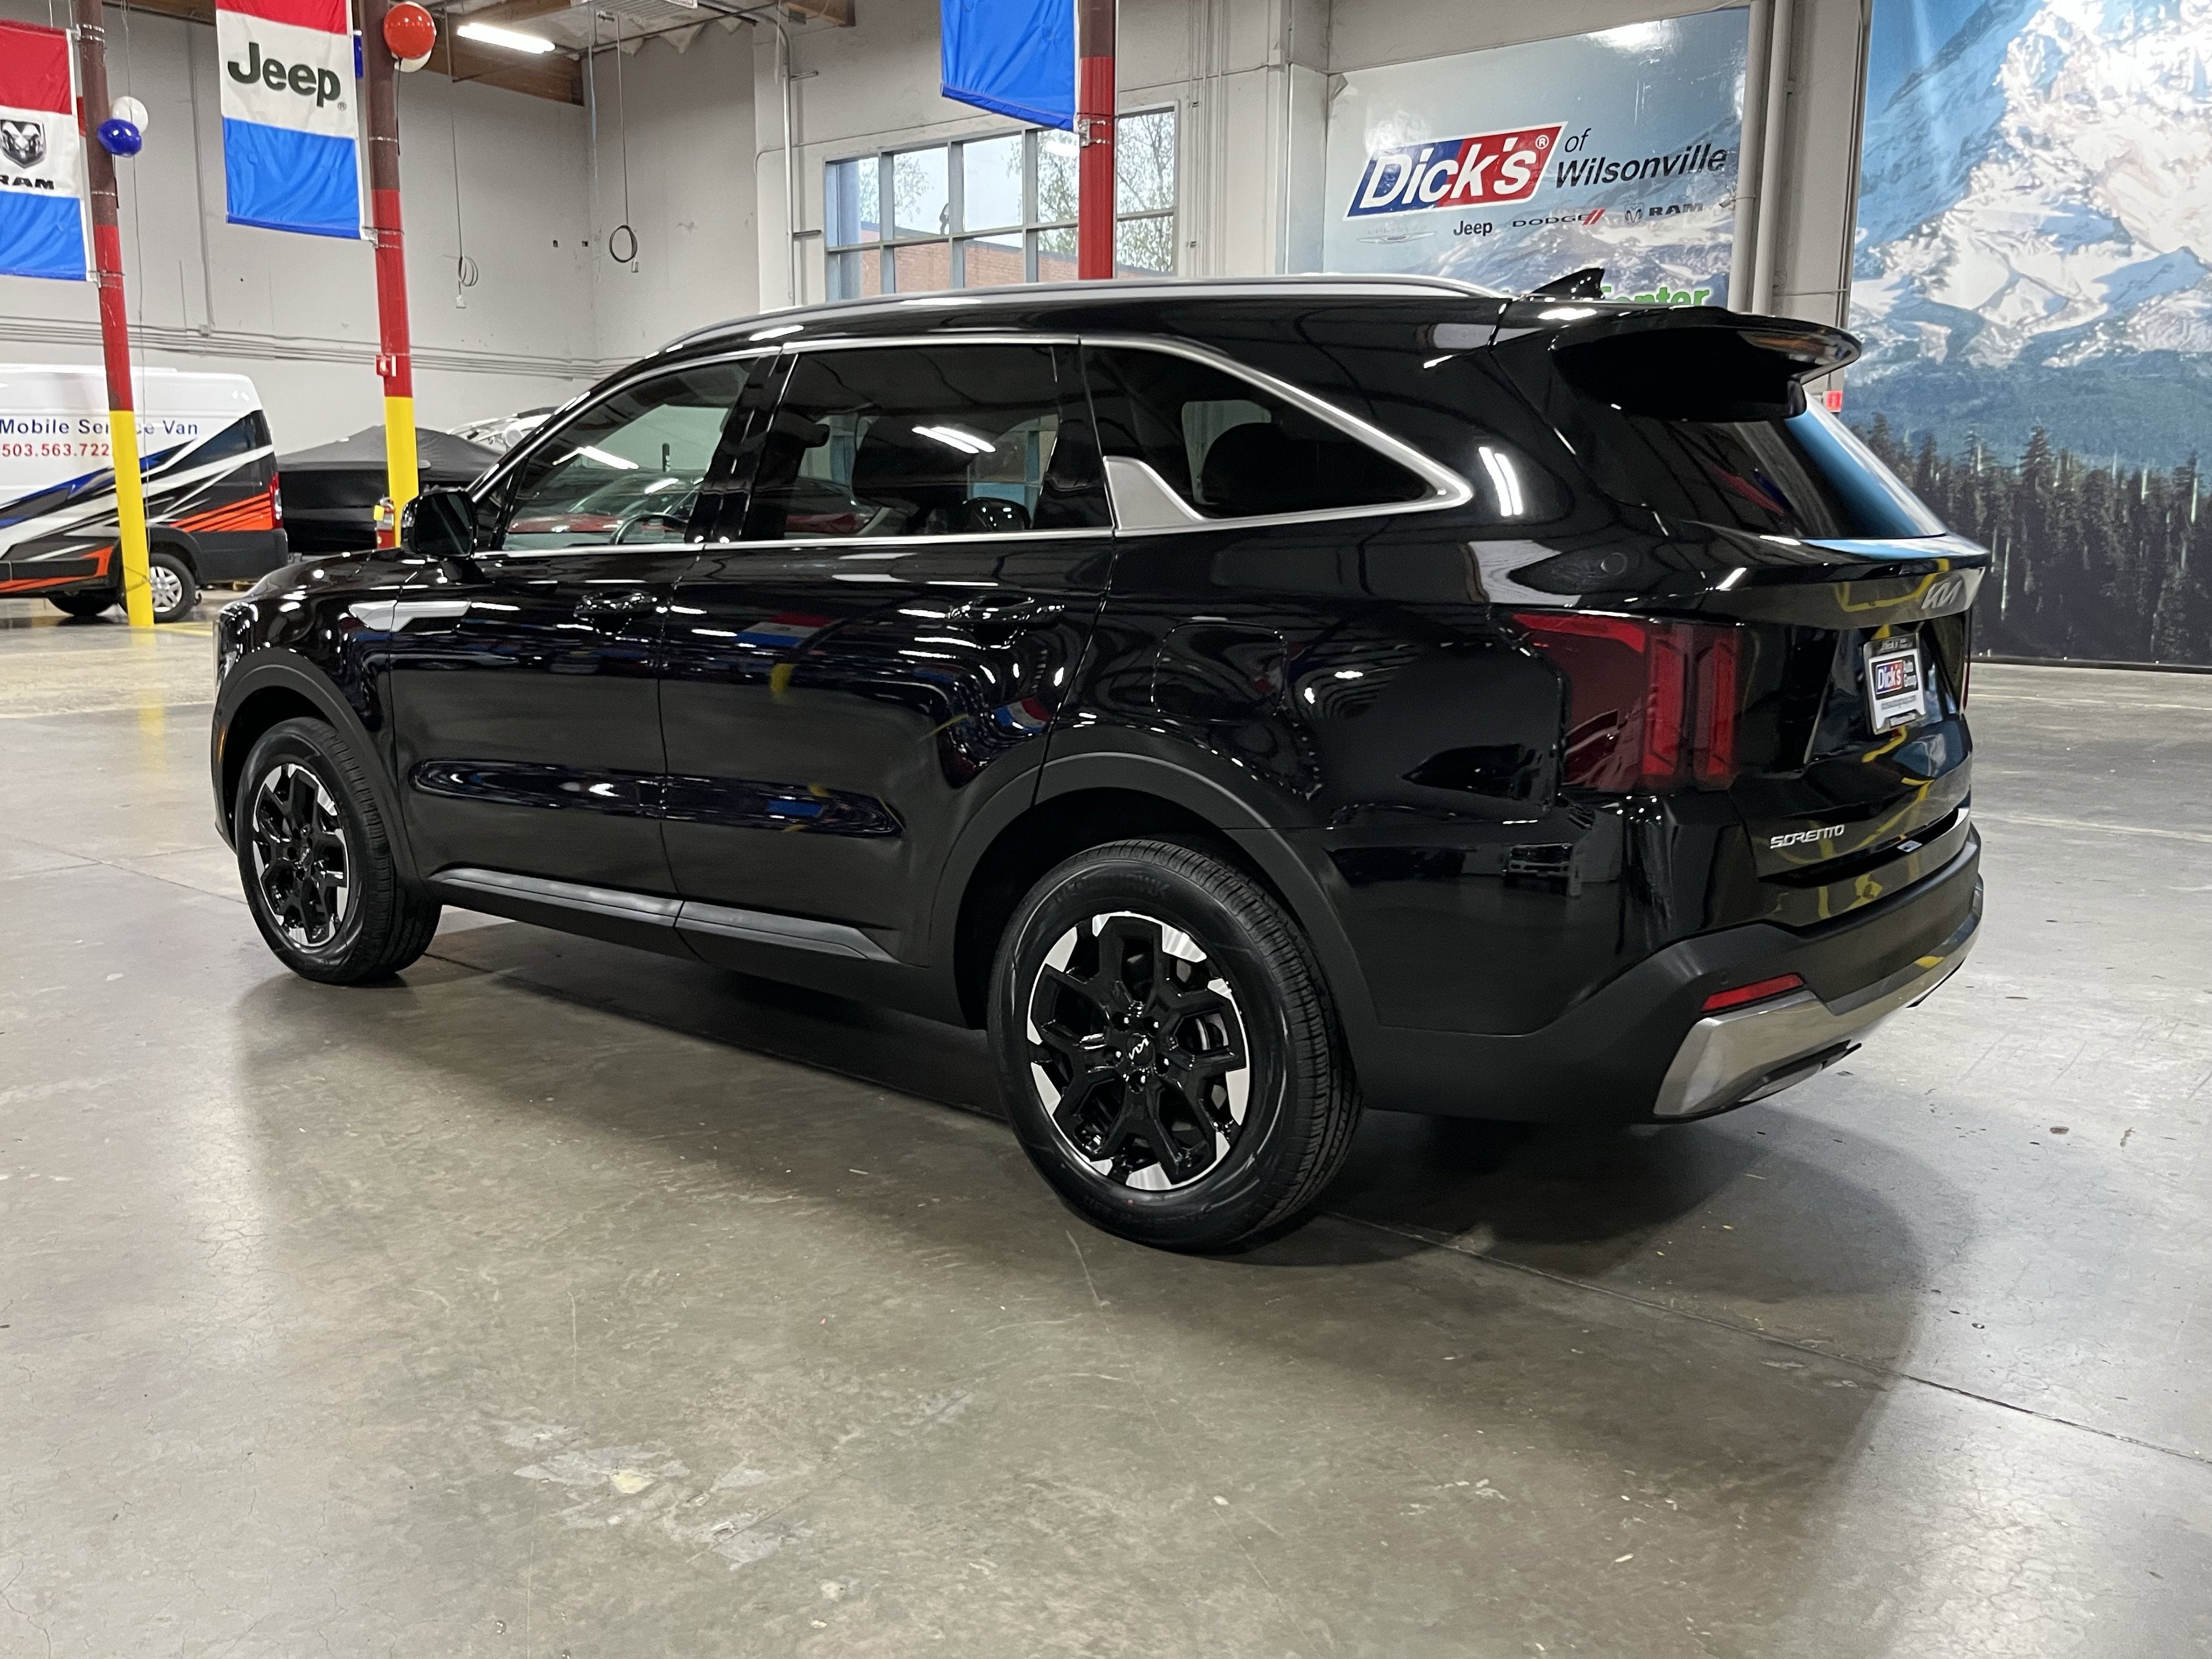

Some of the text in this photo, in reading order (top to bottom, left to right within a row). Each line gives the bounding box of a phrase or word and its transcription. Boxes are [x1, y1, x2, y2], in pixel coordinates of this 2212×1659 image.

[228, 42, 341, 108] Jeep
[1359, 128, 1592, 209] Dick's of
[1556, 144, 1728, 189] Wilsonville
[1453, 203, 1703, 236] Jeep DODGE RAM
[0, 419, 198, 435] Mobile Serce Van
[2, 443, 109, 458] 503.563.722
[1878, 663, 1901, 690] Dick's
[1770, 824, 1845, 849] SORENTO
